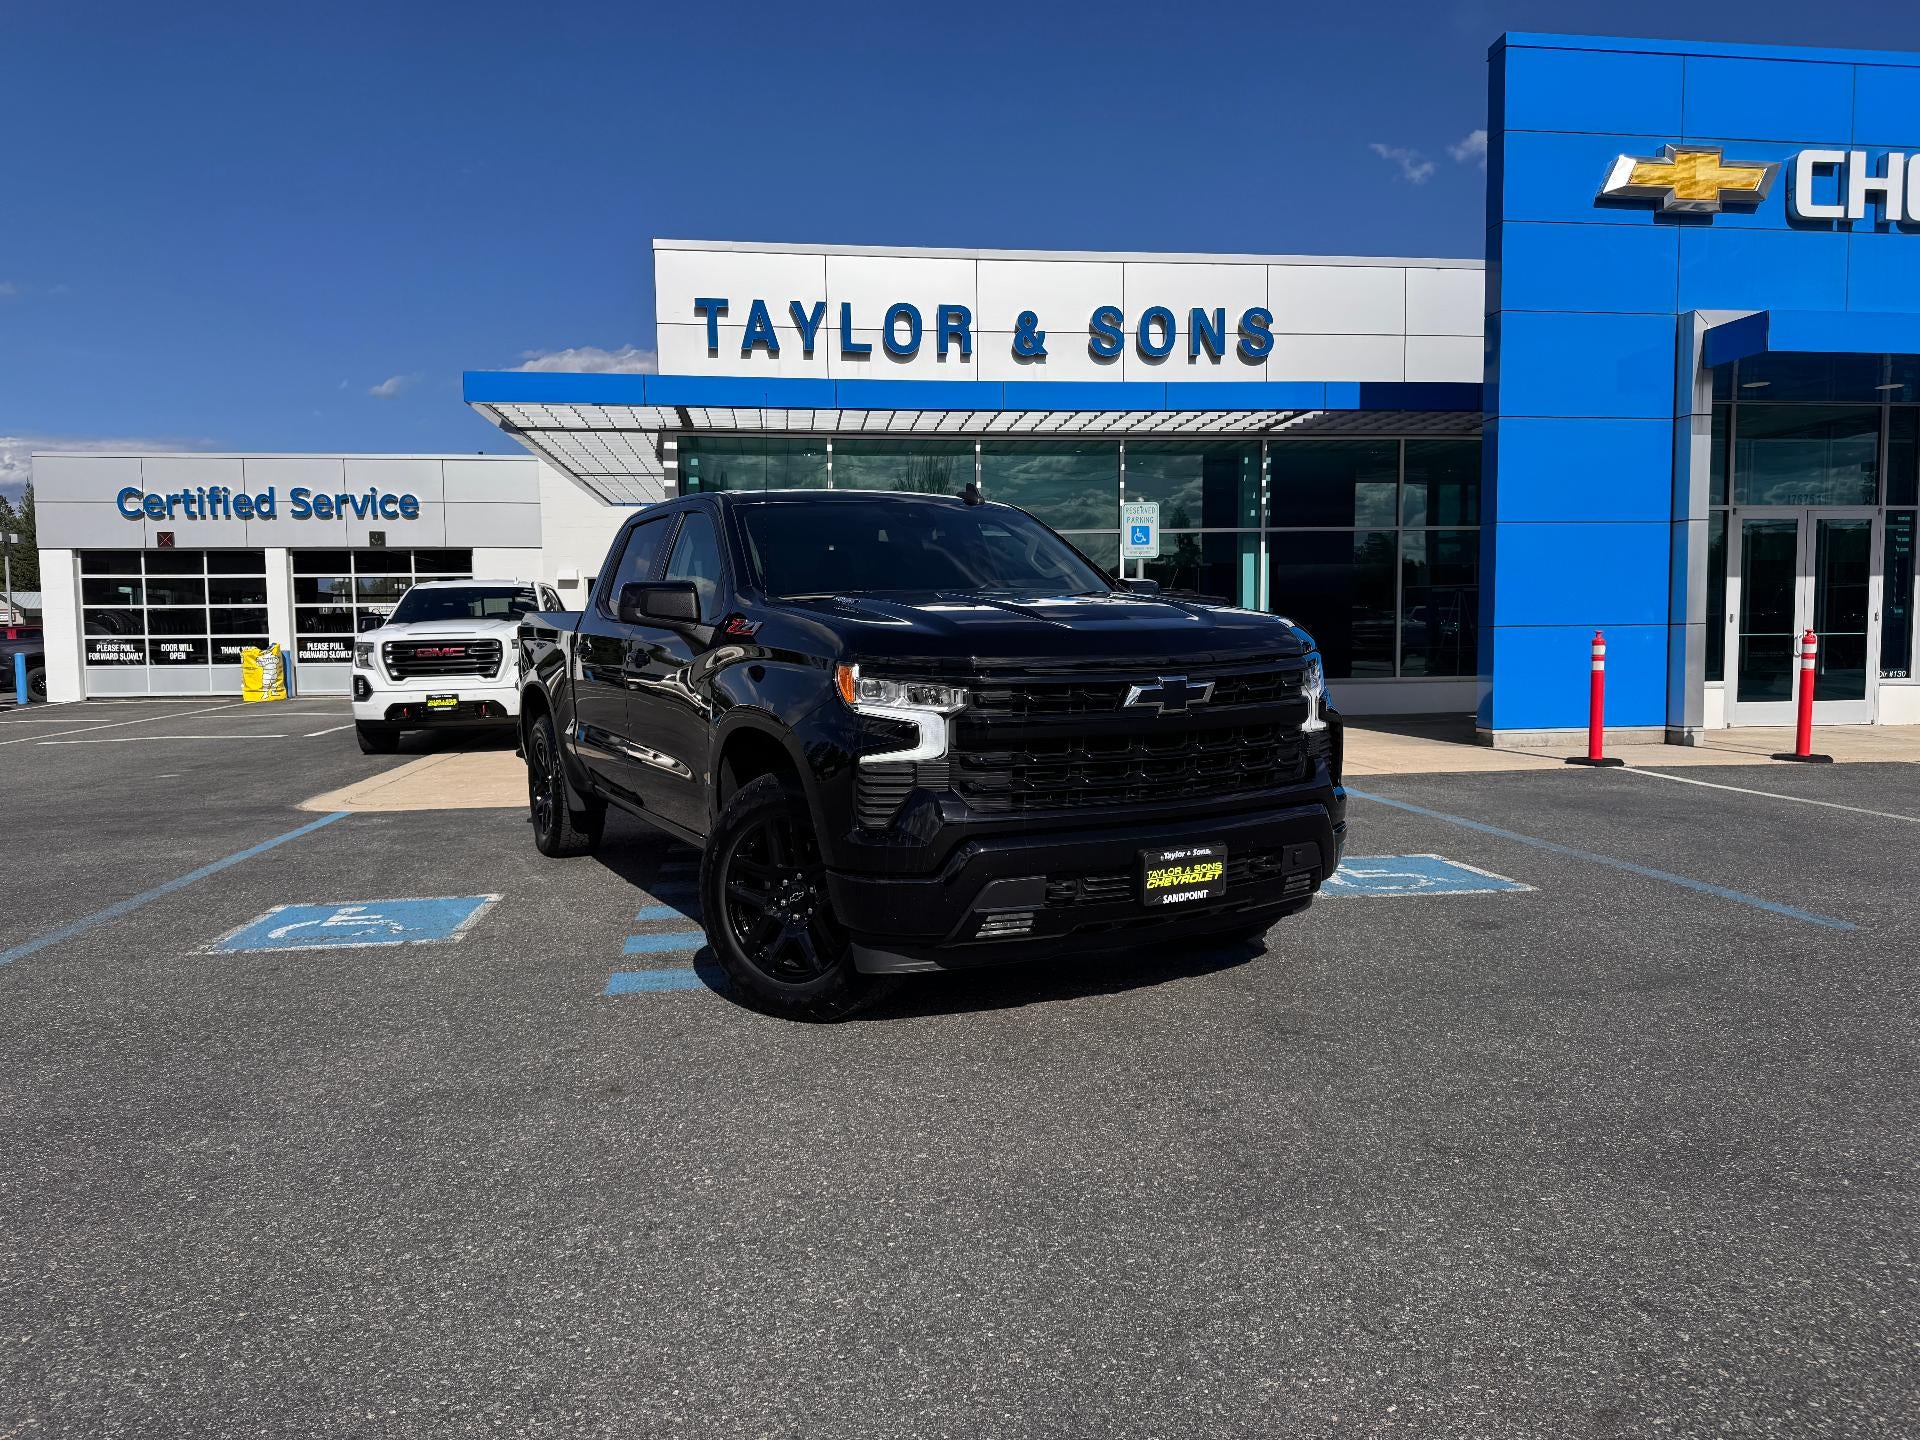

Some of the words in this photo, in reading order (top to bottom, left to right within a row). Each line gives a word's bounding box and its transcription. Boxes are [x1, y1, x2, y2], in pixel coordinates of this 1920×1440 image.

[694, 297, 973, 361] TAYLOR
[1012, 310, 1046, 361] &
[1088, 305, 1275, 362] SONS
[116, 486, 277, 519] Certified
[290, 487, 420, 519] Service
[1125, 506, 1156, 515] RESERVED
[1126, 516, 1154, 524] PARKING
[96, 643, 120, 652] PLEASE
[120, 643, 136, 652] PULL
[160, 643, 178, 652] DOOR
[178, 643, 194, 652] WILL
[220, 646, 241, 655] THANK
[306, 642, 329, 651] PLEASE
[329, 642, 346, 651] PULL
[88, 652, 119, 661] FORWARD
[119, 652, 144, 661] SLOWLY
[169, 651, 186, 660] OPEN
[299, 650, 329, 659] FORWARD
[329, 650, 353, 659] SLOWLY
[416, 647, 466, 657] GMC
[1163, 851, 1186, 861] Taylor
[1147, 866, 1183, 880] TAYLOR
[1184, 866, 1192, 874] &
[1193, 862, 1224, 873] SONS
[1146, 870, 1222, 889] CHEVROLET
[1162, 889, 1210, 904] SANDPOINT
